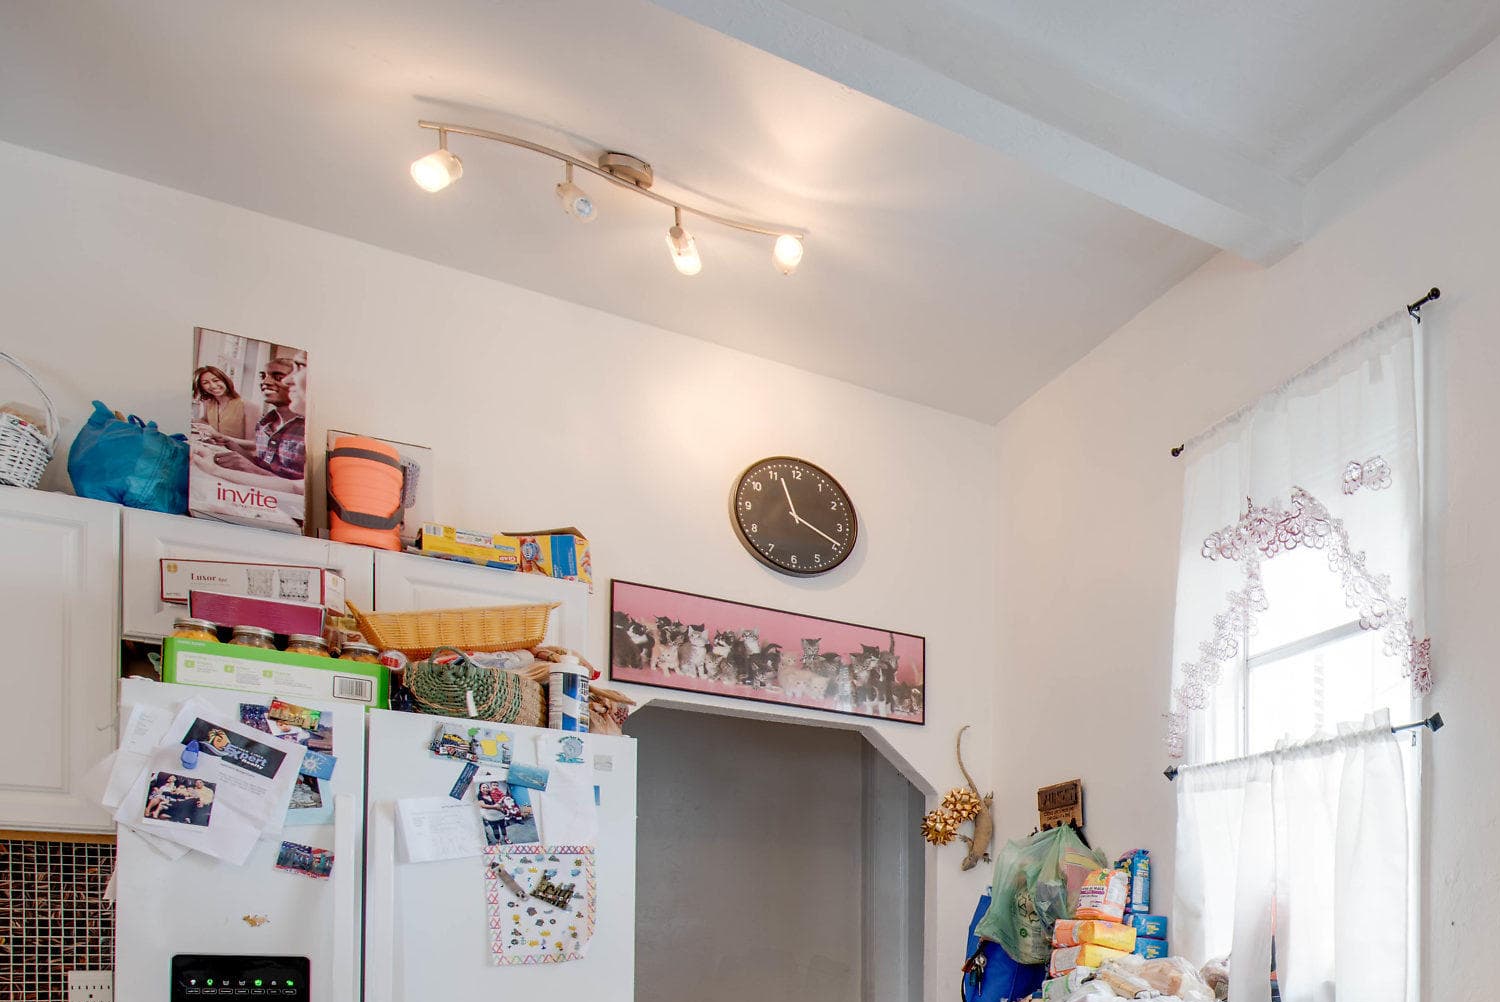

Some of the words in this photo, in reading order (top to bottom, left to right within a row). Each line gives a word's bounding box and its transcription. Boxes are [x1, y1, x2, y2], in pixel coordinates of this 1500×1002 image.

[769, 471, 778, 480] 11
[792, 470, 802, 480] 12
[752, 482, 762, 491] 10
[216, 482, 278, 509] invite
[745, 501, 752, 510] 9
[831, 501, 837, 510] 2
[751, 523, 757, 532] 8
[837, 524, 843, 532] 3
[768, 543, 774, 552] 7
[791, 555, 798, 564] 6
[814, 554, 821, 562] 5
[190, 573, 217, 582] Luxor
